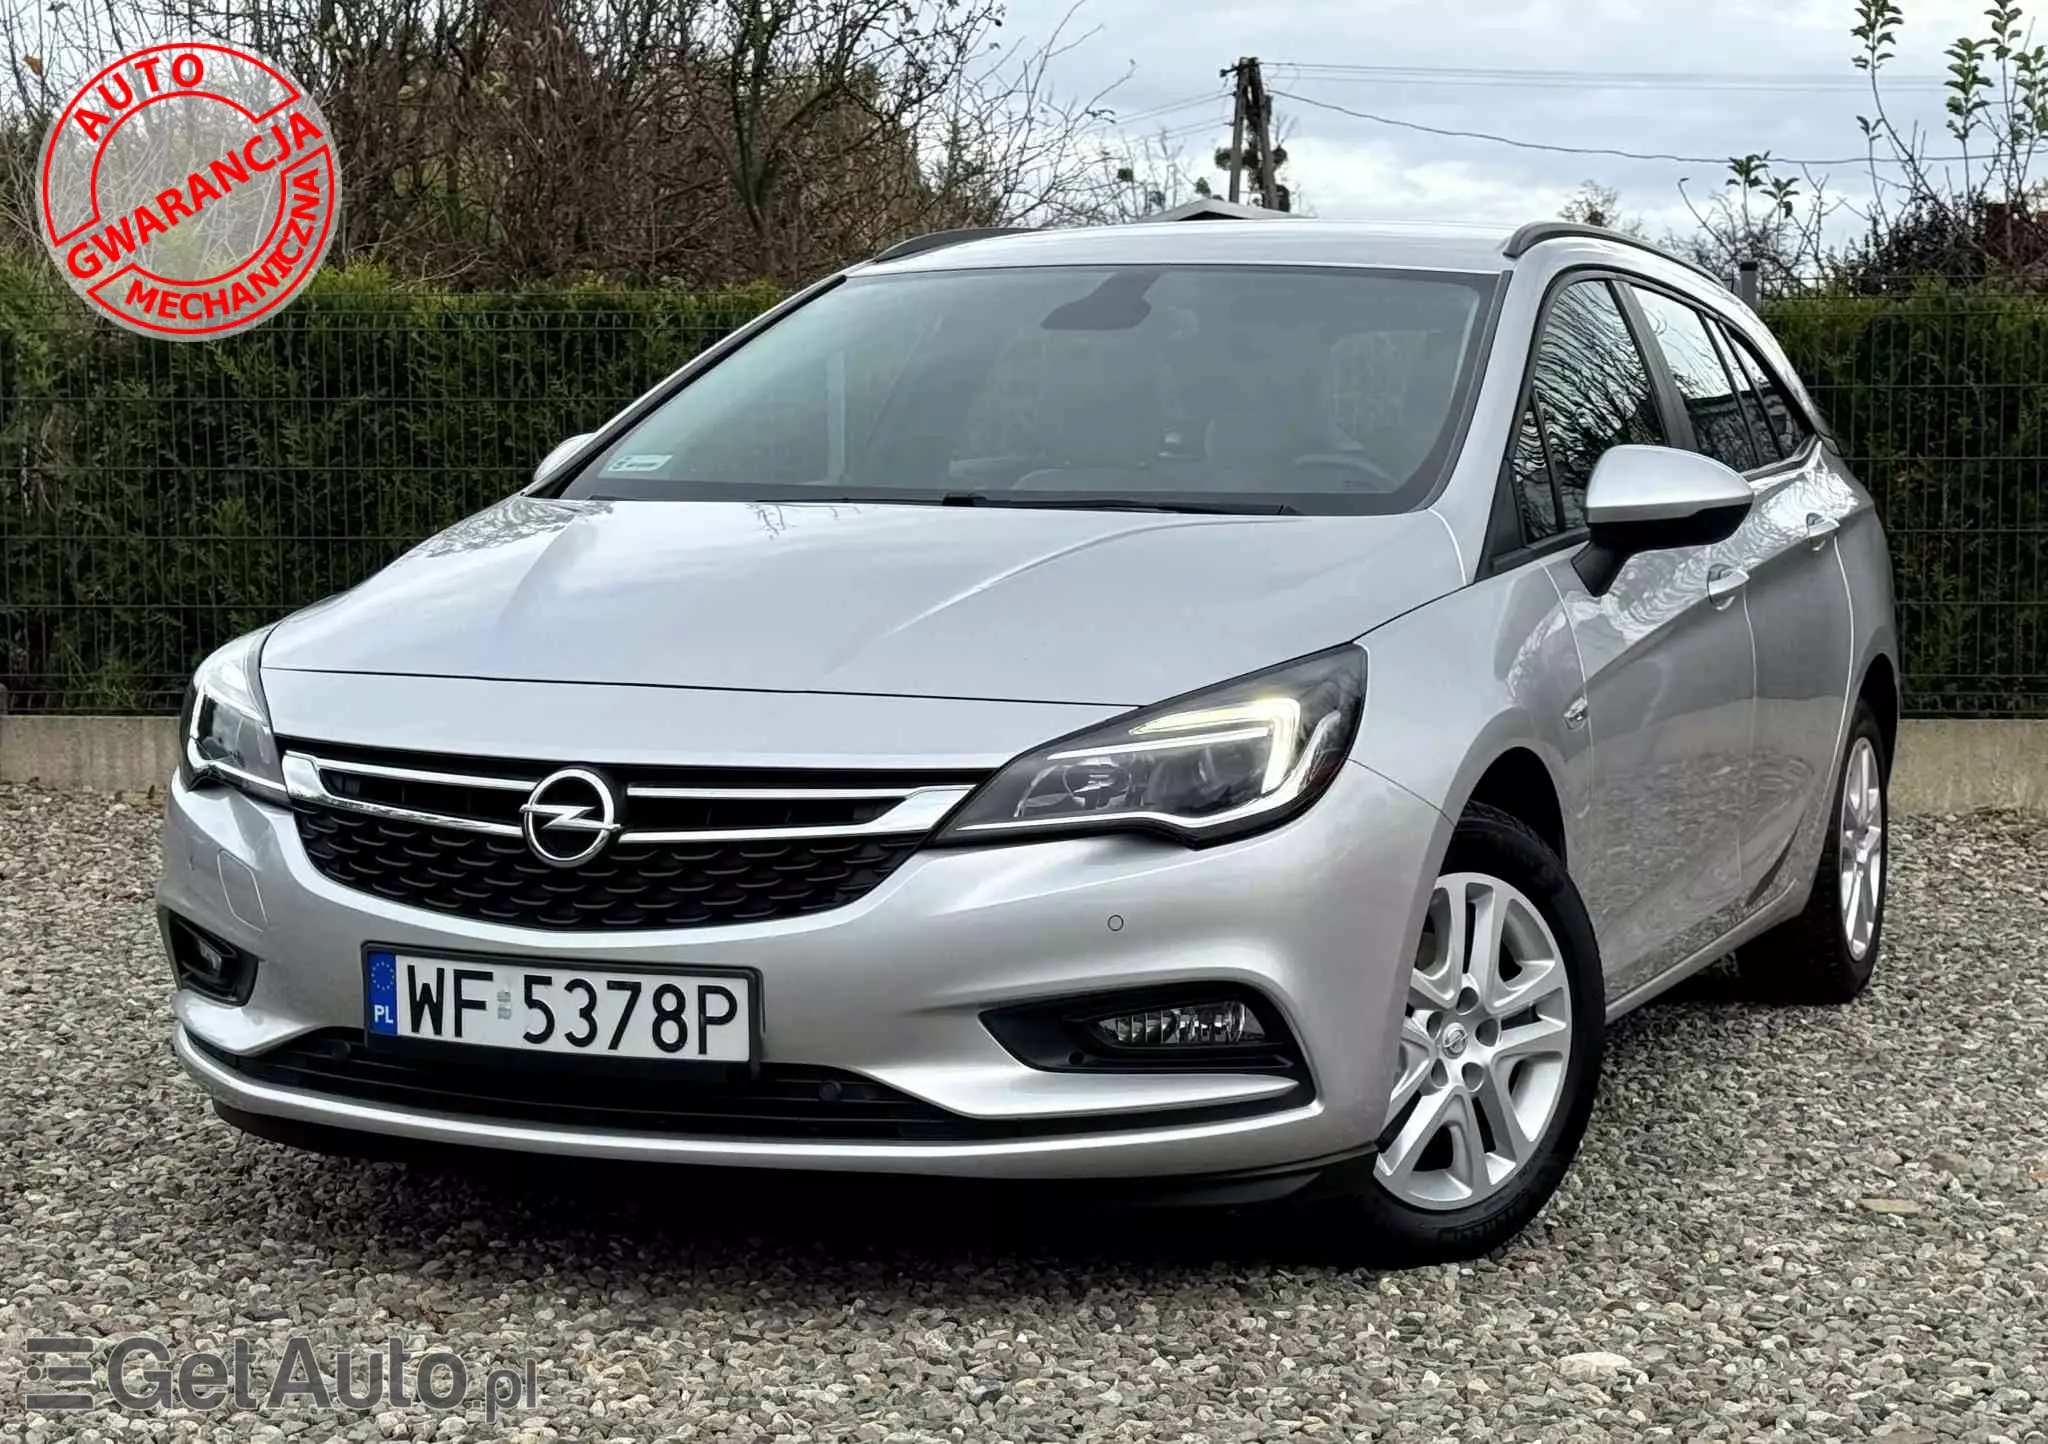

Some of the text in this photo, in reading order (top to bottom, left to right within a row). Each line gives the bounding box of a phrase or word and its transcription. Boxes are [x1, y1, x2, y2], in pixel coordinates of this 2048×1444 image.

[374, 1004, 394, 1024] PL
[407, 965, 739, 1055] WF 5378P
